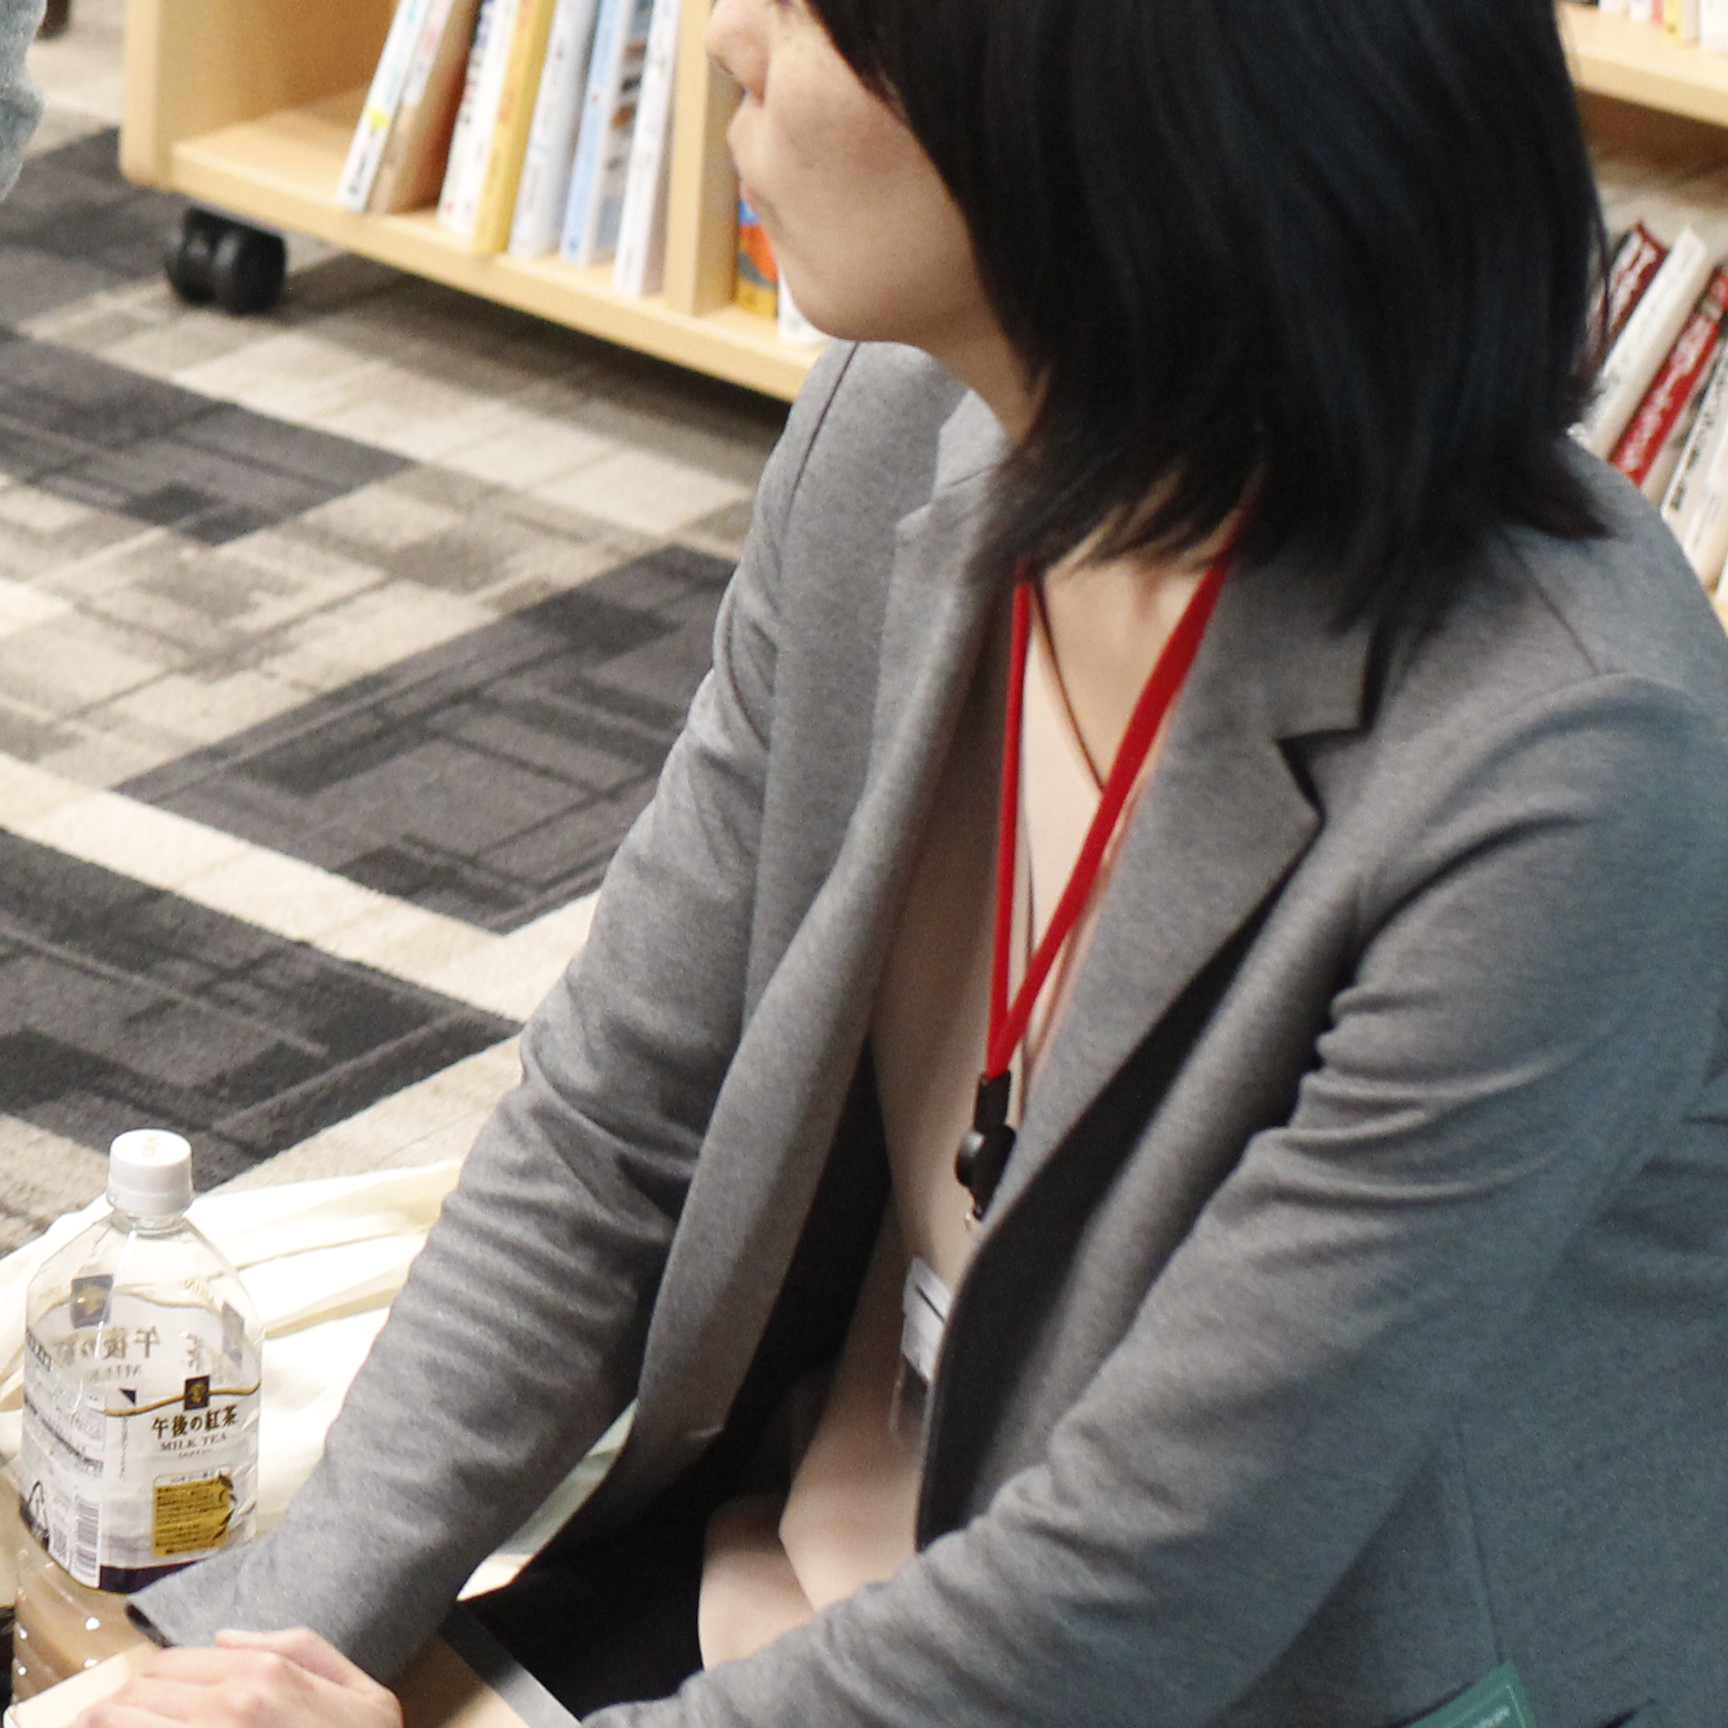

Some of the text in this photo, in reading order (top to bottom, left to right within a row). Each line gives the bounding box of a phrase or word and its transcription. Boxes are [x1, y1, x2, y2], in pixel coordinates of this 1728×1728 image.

[151, 1404, 239, 1439] 午後の紅茶
[160, 1431, 227, 1452] MILK TEA
